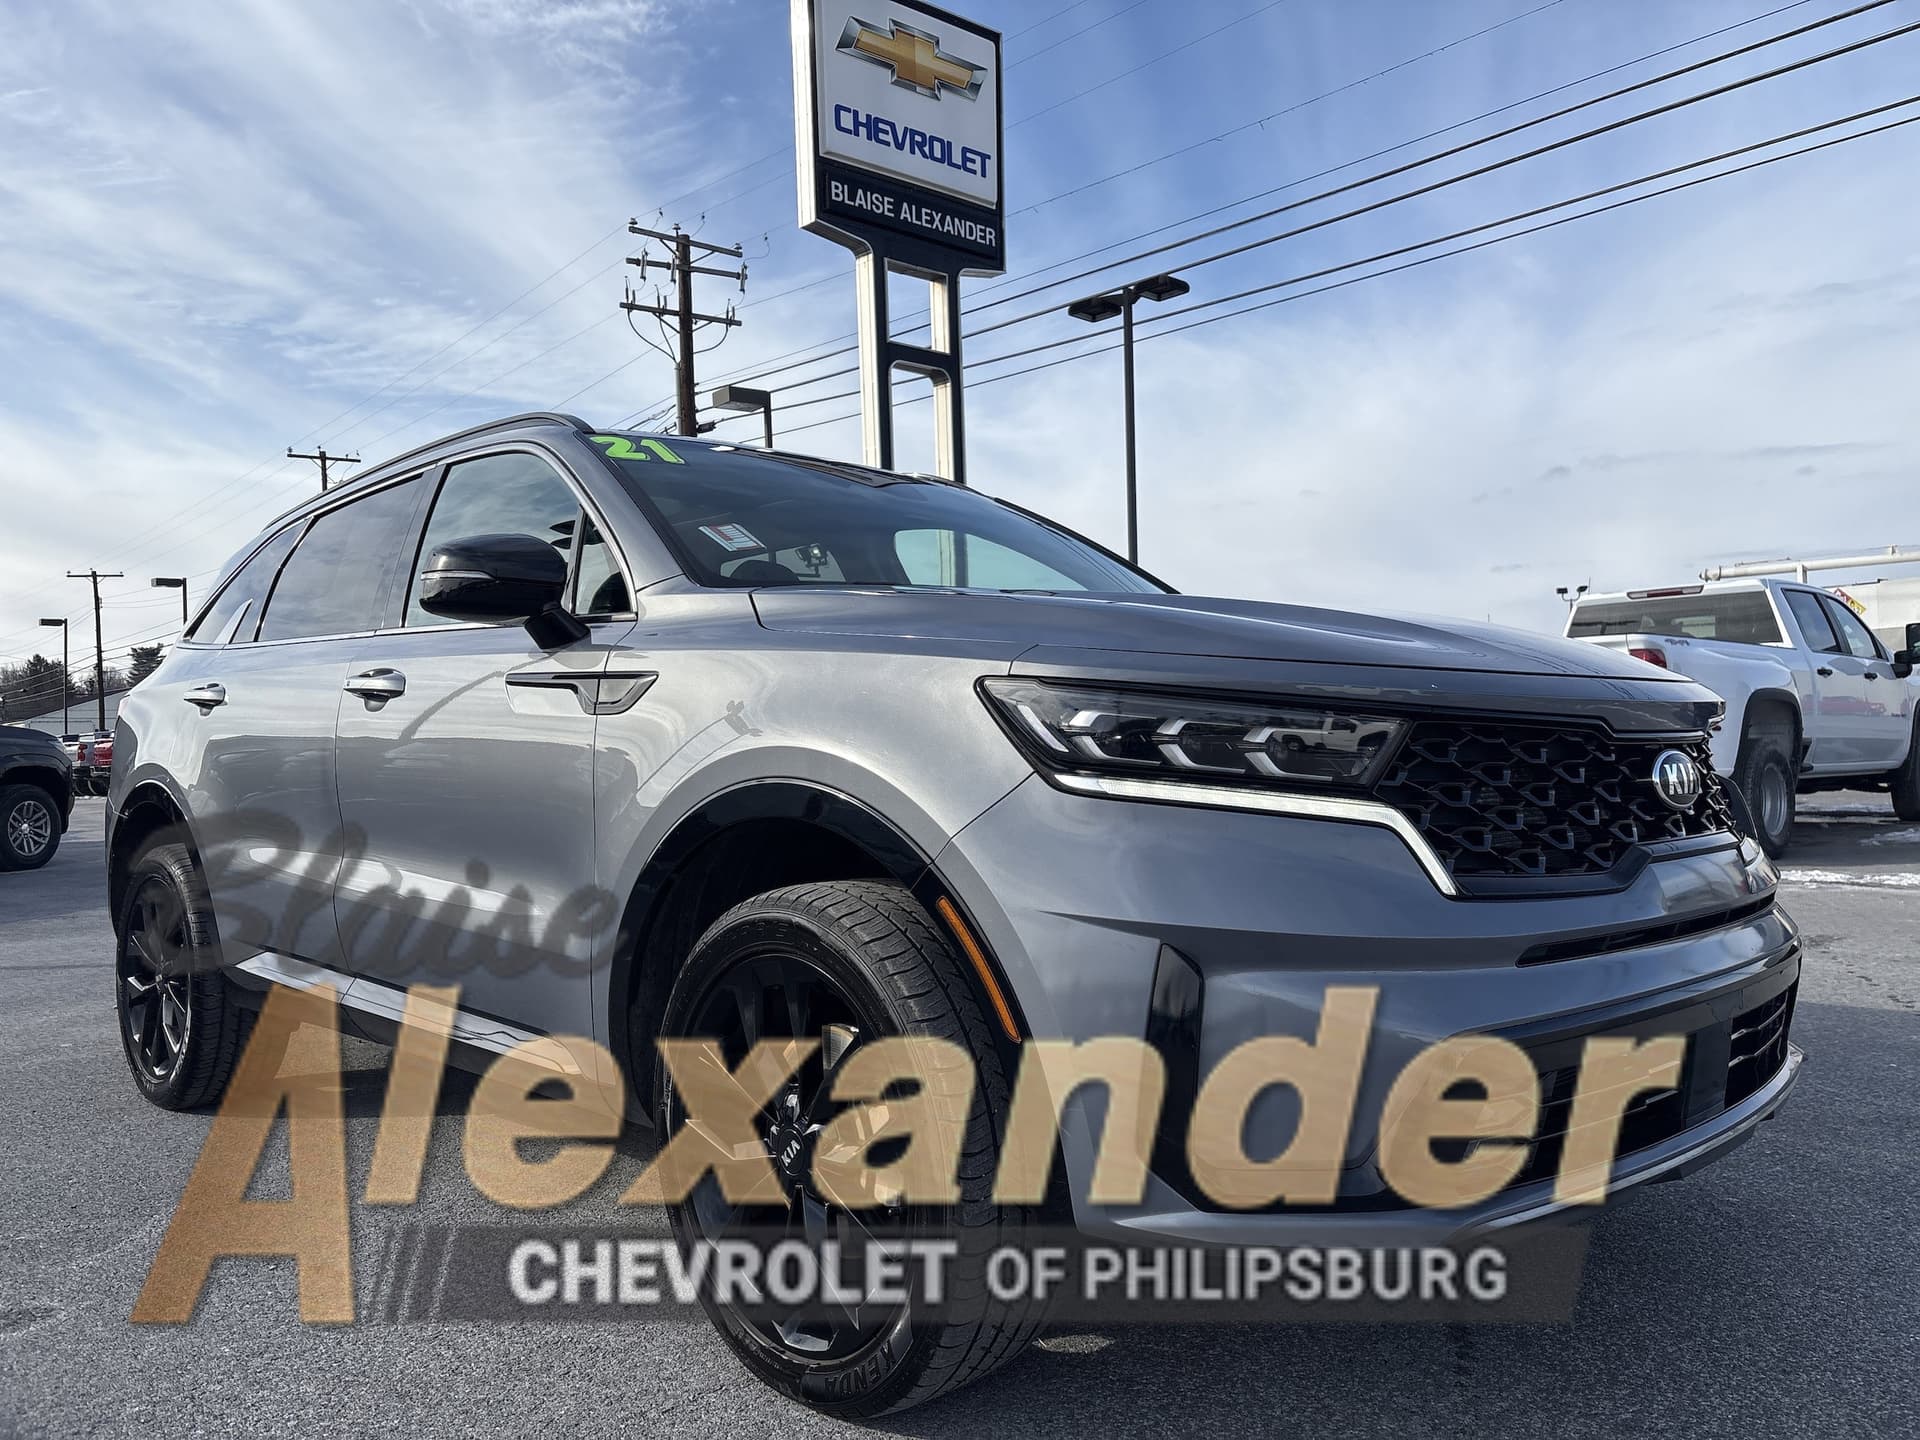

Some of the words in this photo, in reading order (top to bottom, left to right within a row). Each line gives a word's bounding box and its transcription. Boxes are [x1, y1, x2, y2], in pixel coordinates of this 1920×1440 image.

[834, 103, 991, 178] CHEVROLET
[831, 180, 895, 217] BLAISE
[900, 202, 996, 247] ALEXANDER
[590, 436, 685, 464] 21
[1664, 762, 1703, 796] KIA
[780, 1139, 801, 1167] KIA
